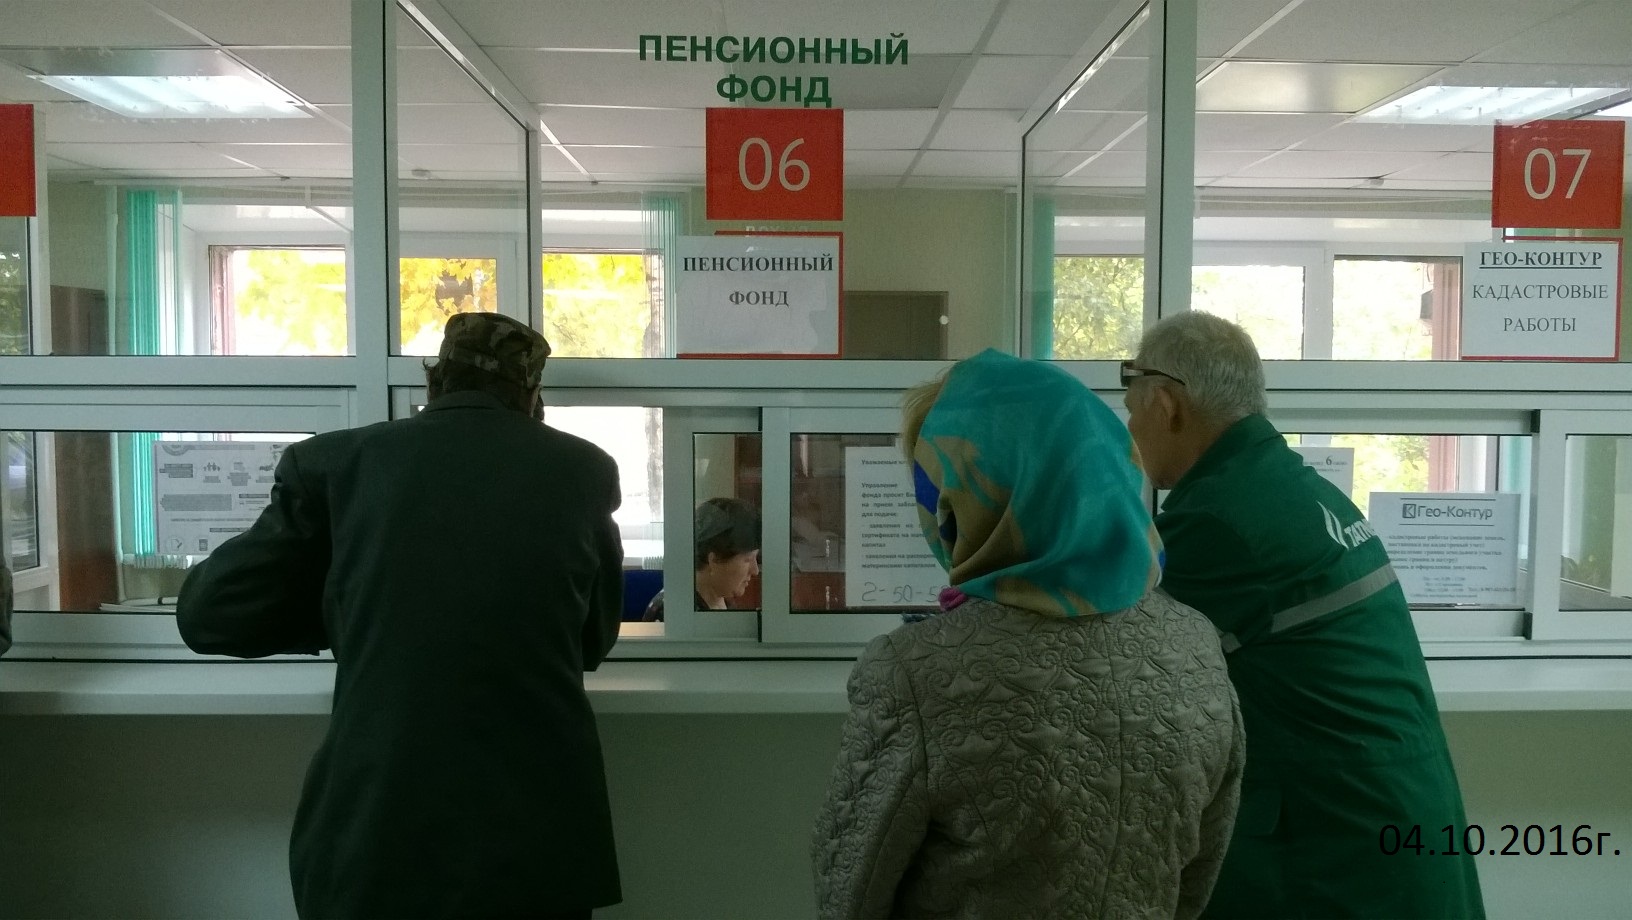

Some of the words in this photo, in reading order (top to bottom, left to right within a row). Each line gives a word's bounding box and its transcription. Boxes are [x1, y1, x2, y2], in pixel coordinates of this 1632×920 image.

[638, 32, 909, 65] ПЕНСИОННЫЙ
[716, 73, 833, 108] ФОНД
[738, 137, 811, 192] 06
[1524, 147, 1592, 200] 07
[682, 252, 834, 272] ПЕНСИОННЫЙ
[1479, 250, 1603, 267] ГЕО-КОНТУР
[728, 290, 790, 308] ФОНД
[1471, 283, 1609, 302] КАДАСТРОВЫЕ
[1502, 316, 1577, 332] РАБОТЫ
[1325, 455, 1333, 466] 6
[1417, 504, 1494, 520] Гео-Контур
